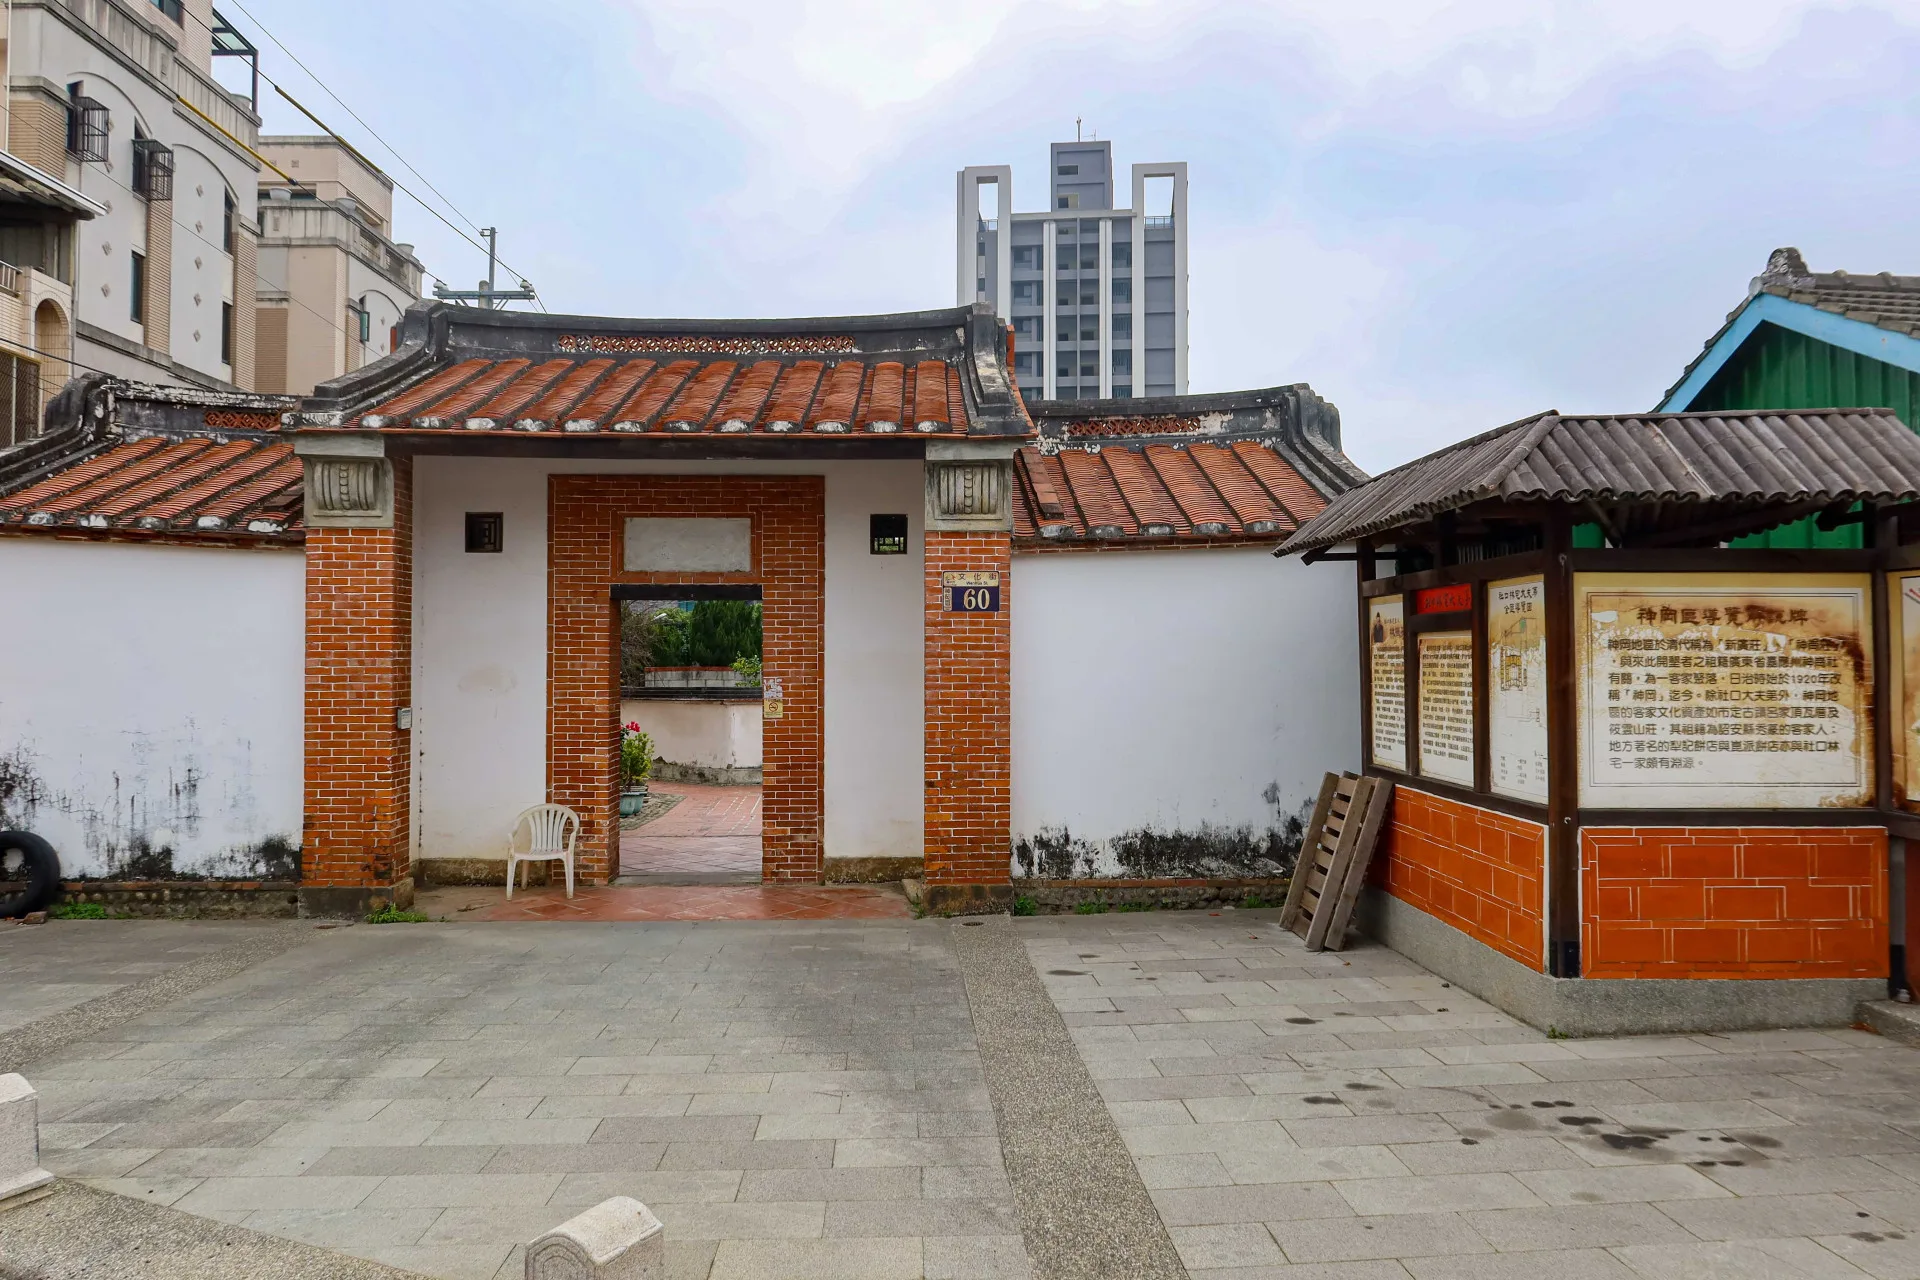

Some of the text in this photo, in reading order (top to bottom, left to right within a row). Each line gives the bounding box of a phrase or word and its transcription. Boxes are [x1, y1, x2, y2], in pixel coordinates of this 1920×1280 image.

[958, 572, 997, 580] 文化街
[963, 588, 990, 610] 60
